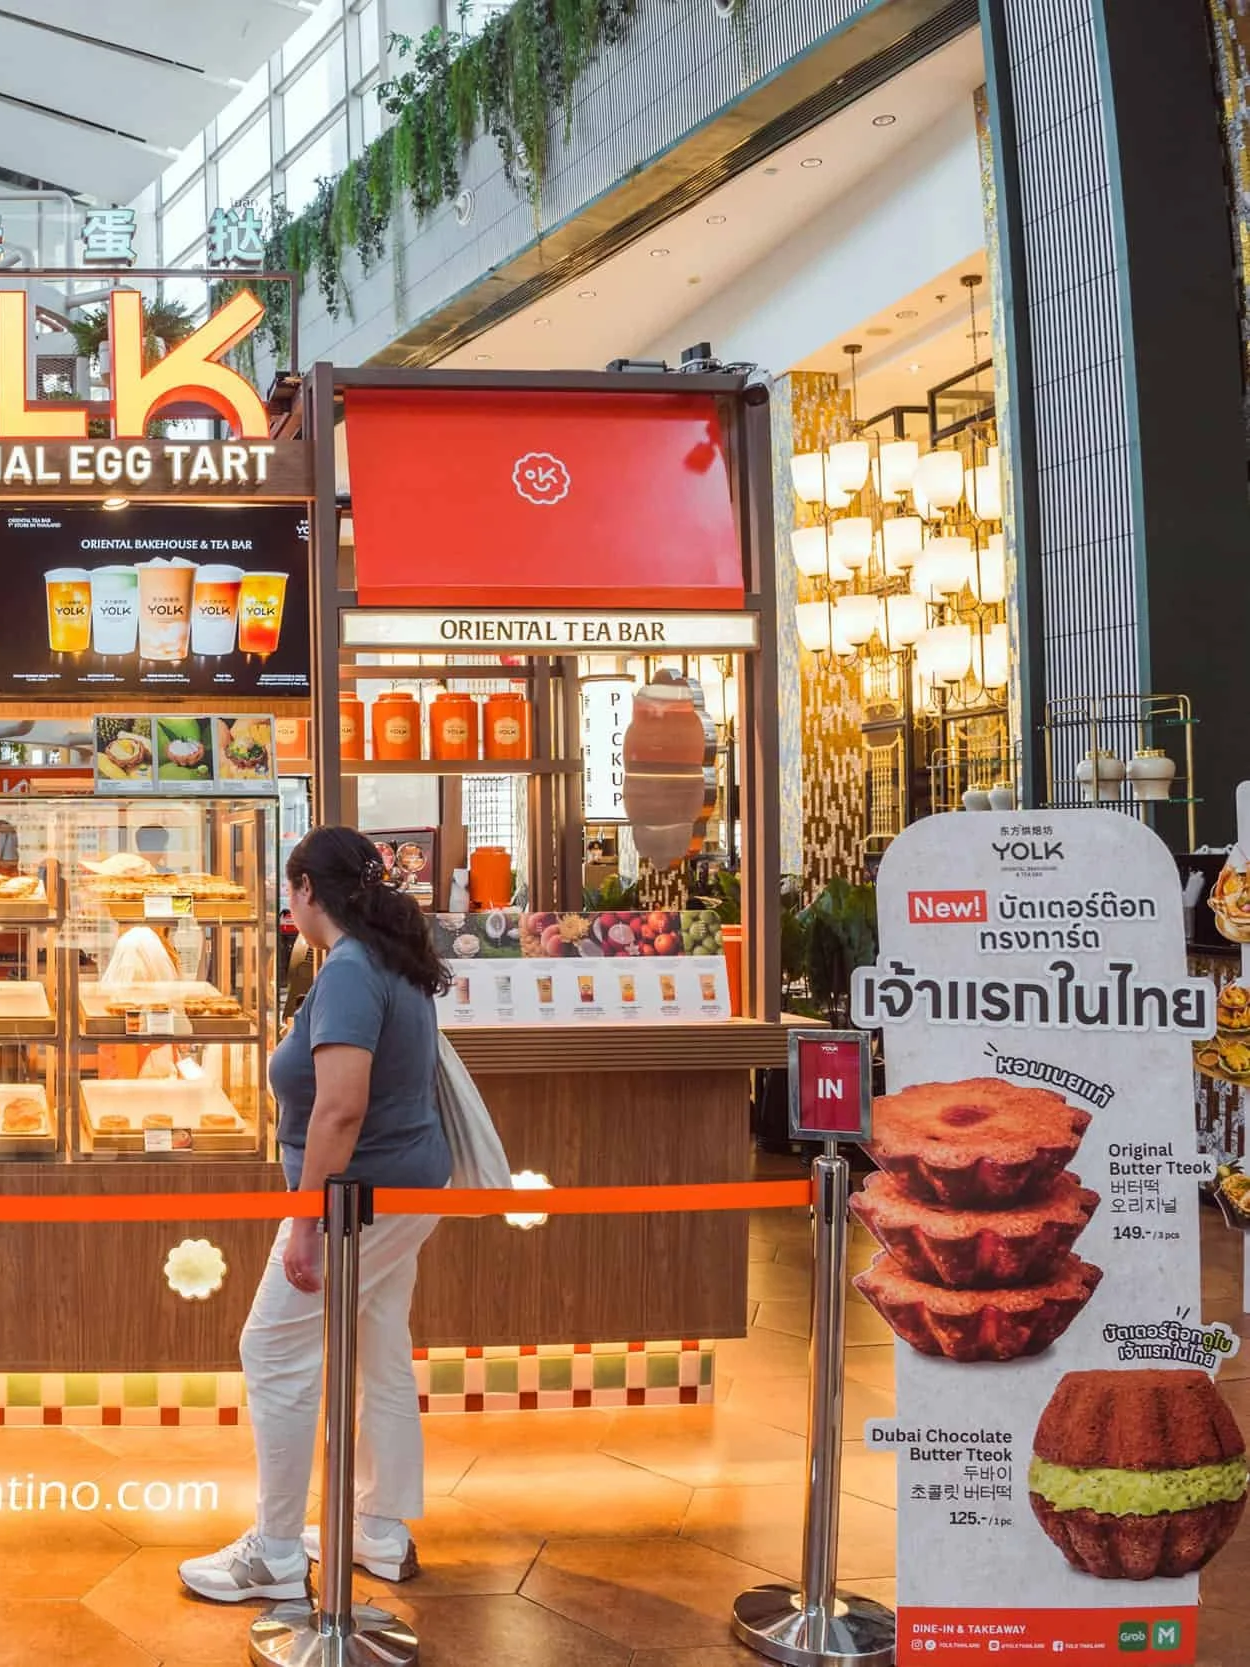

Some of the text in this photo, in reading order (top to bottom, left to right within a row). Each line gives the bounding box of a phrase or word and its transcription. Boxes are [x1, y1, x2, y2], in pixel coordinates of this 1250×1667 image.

[69, 445, 151, 483] EGG
[170, 445, 275, 483] TART
[81, 539, 253, 550] ORIENTAL BAKEHOUSE & TEA BAR
[55, 607, 86, 616] YOLK
[100, 607, 131, 616] YOLK
[148, 605, 184, 616] YOLK
[200, 607, 231, 616] YOLK
[246, 607, 275, 616] YOLK
[440, 620, 665, 641] ORIENTAL TEA BAR
[991, 841, 1064, 860] YOLK
[914, 897, 981, 919] New!
[999, 893, 1156, 919] บัตเตอร์ต๊อก
[980, 923, 1100, 950] ทรงทาร์ต
[864, 960, 1206, 1028] เจ้าแรกในไทย
[817, 1078, 843, 1099] IN
[997, 1056, 1114, 1108] หอมเนยแท้
[1109, 1142, 1174, 1160] Original
[1110, 1160, 1212, 1175] Butter Tteok
[1110, 1179, 1159, 1195] 버터떡
[1110, 1196, 1176, 1214] 오리지널
[1165, 1231, 1180, 1240] pcs
[1118, 1341, 1215, 1368] เจ้าแรกในไทย
[872, 1428, 1012, 1443] Dubai Chocolate
[910, 1448, 1013, 1461] Butter Tteok
[963, 1465, 1012, 1481] 두바이
[910, 1484, 1012, 1500] 초콜릿 버터떡
[912, 1624, 1027, 1635] DINE-IN & TAKEAWAY
[1120, 1631, 1147, 1642] Grab
